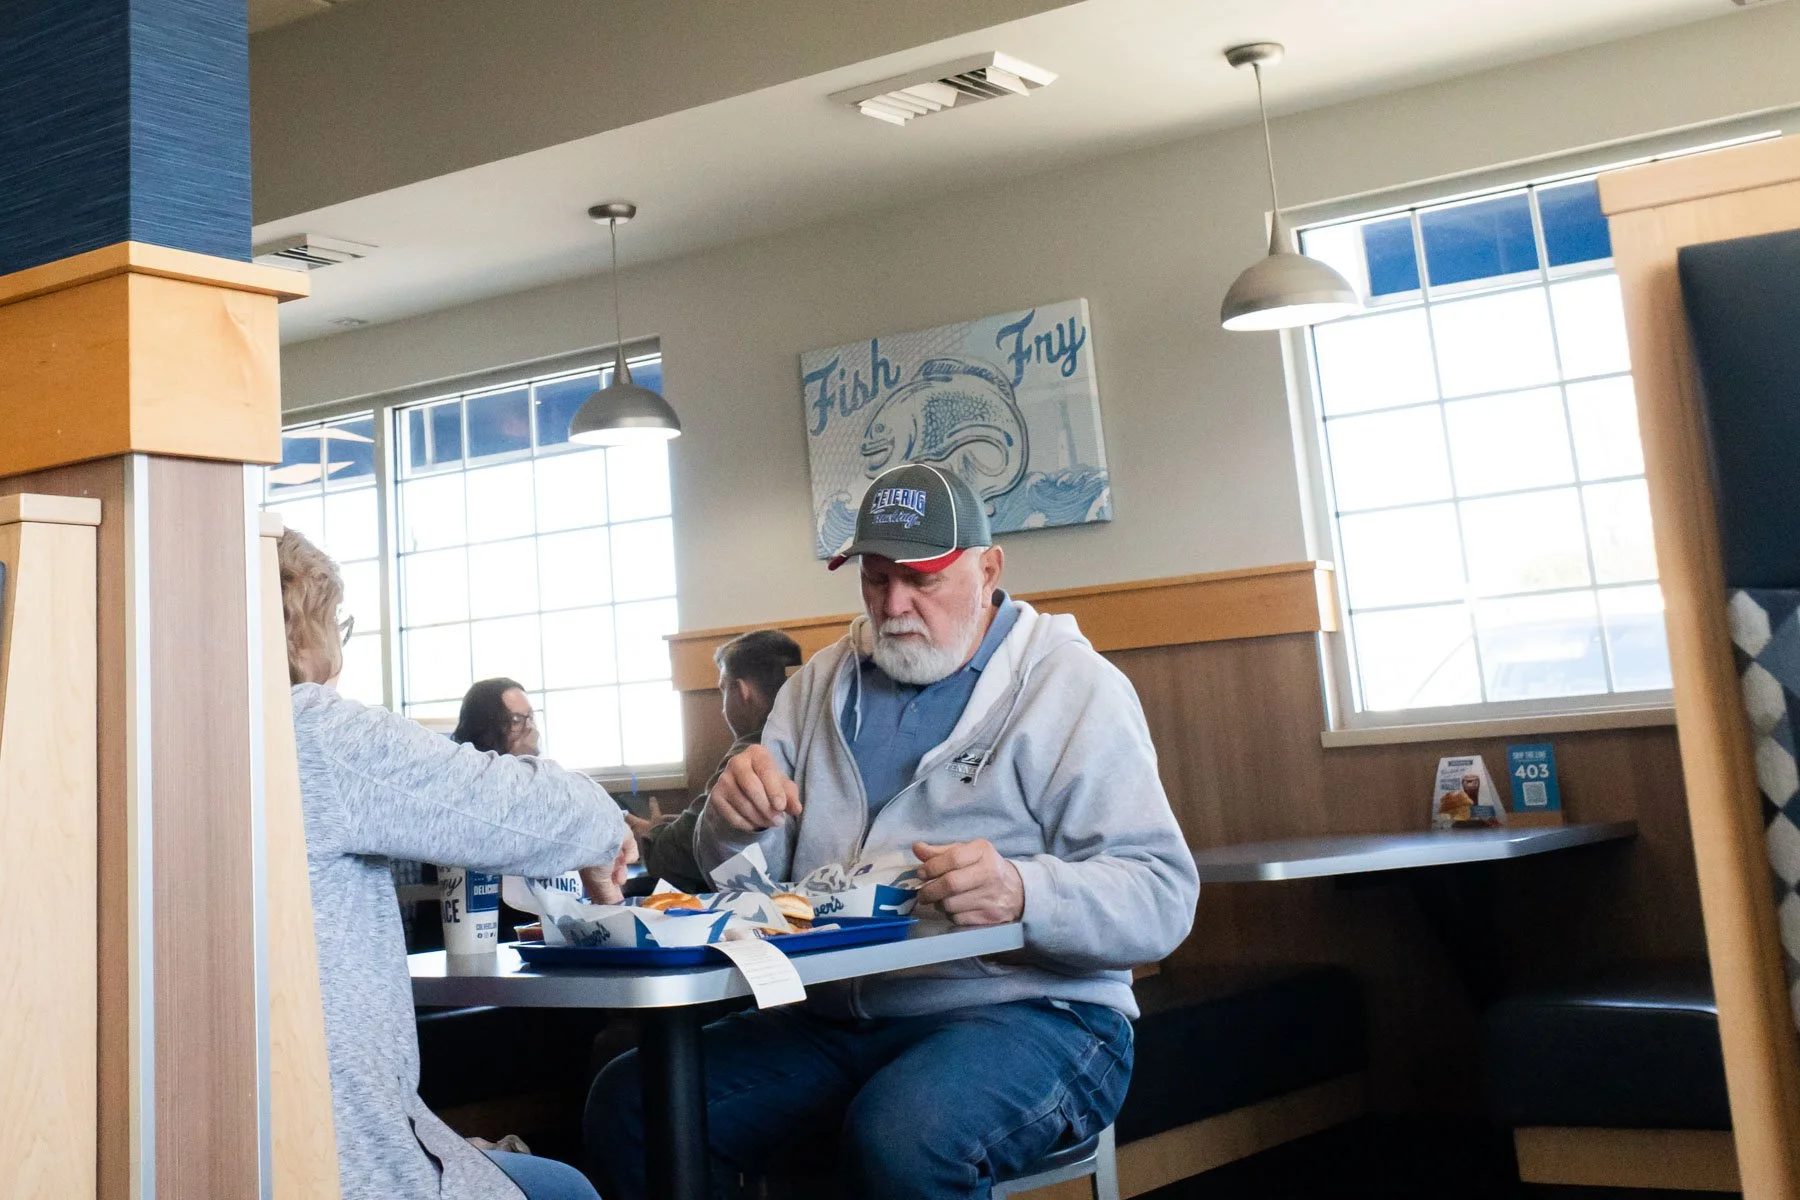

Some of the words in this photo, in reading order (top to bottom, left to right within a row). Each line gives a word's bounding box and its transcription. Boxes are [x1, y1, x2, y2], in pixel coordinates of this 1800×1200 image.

[803, 337, 900, 437] Fish
[996, 308, 1086, 388] Fry
[1515, 763, 1549, 779] 403
[814, 895, 844, 917] ver's
